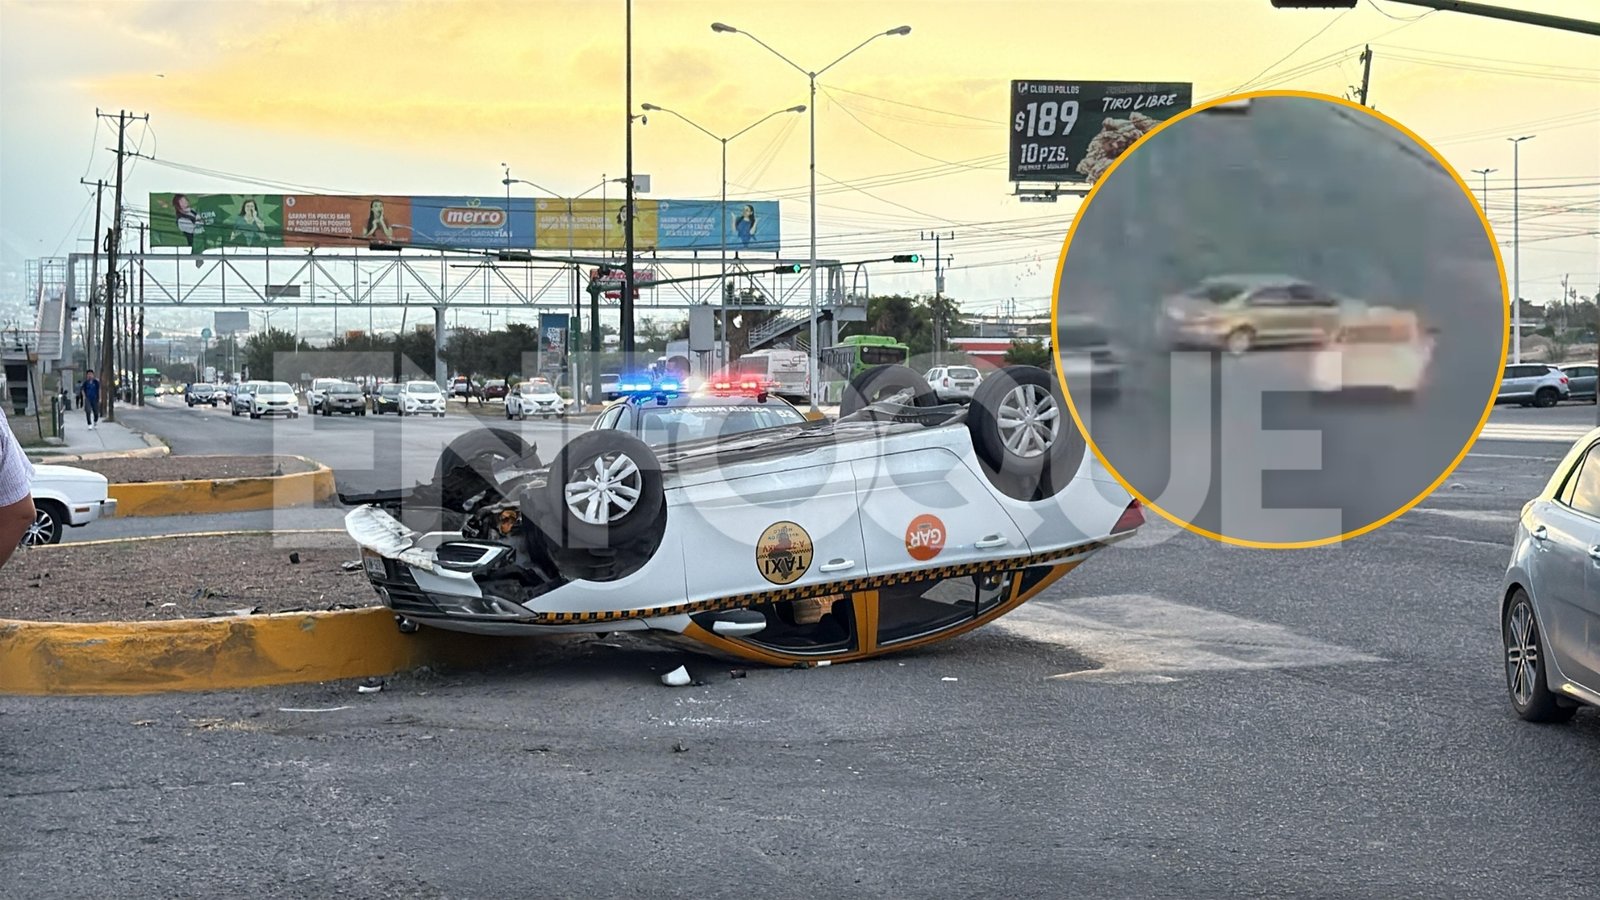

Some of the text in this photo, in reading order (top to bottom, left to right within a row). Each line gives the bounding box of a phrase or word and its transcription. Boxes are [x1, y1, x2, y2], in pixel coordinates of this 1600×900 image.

[1030, 84, 1047, 94] CLUB
[1055, 85, 1080, 94] POLLOS
[1102, 93, 1177, 113] TIRO LIBRE
[1015, 100, 1079, 137] $189
[447, 210, 501, 223] merco
[910, 528, 942, 548] GAR
[765, 555, 806, 575] TAXI
